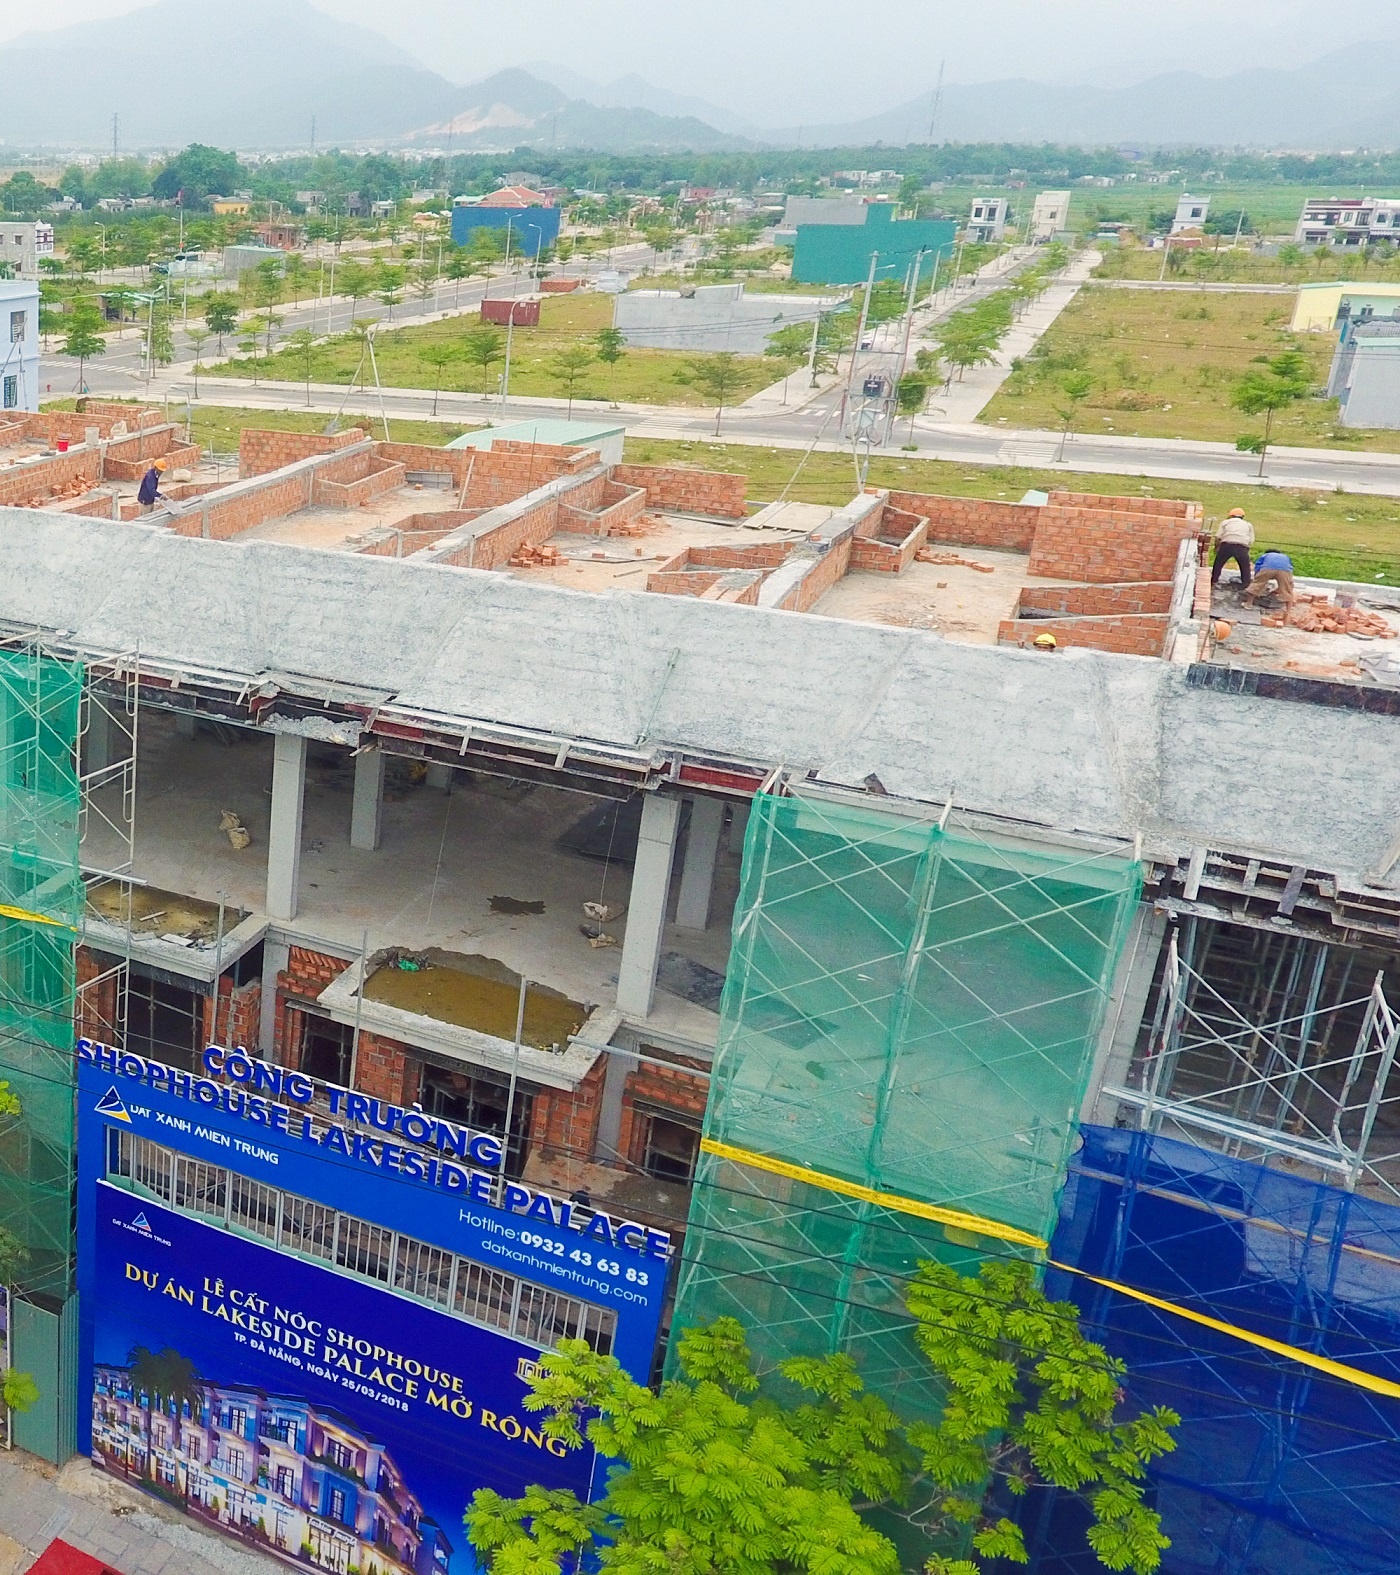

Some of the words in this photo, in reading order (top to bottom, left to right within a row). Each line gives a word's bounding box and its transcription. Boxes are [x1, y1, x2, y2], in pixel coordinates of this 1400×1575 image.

[77, 1037, 290, 1134] SHOPHOUSE
[302, 1112, 494, 1204] LAKESIDE
[504, 1181, 674, 1260] PALACE
[155, 1111, 192, 1134] XANH
[233, 1137, 279, 1166] TRUNG
[203, 1045, 314, 1103] CÔNG
[325, 1083, 503, 1167] TRƯỜNG
[481, 1239, 649, 1308] datxanhmientrung.com
[569, 1248, 593, 1268] 43
[596, 1257, 621, 1277] 63
[625, 1267, 650, 1287] 83
[125, 1262, 159, 1291] DỰ
[162, 1277, 195, 1306] ÁN
[201, 1295, 317, 1357] LAKESIDE
[323, 1345, 419, 1399] PALACE
[425, 1387, 473, 1419] MỞ
[481, 1408, 568, 1458] RỘNG
[229, 1291, 270, 1315] CẤT
[275, 1306, 322, 1338] NÓC
[326, 1327, 464, 1395] SHOPHOUSE
[233, 1331, 248, 1345] TP.
[249, 1340, 266, 1353] ĐÀ
[306, 1362, 339, 1383] NGÀY
[341, 1377, 410, 1413] 25/03/2018
